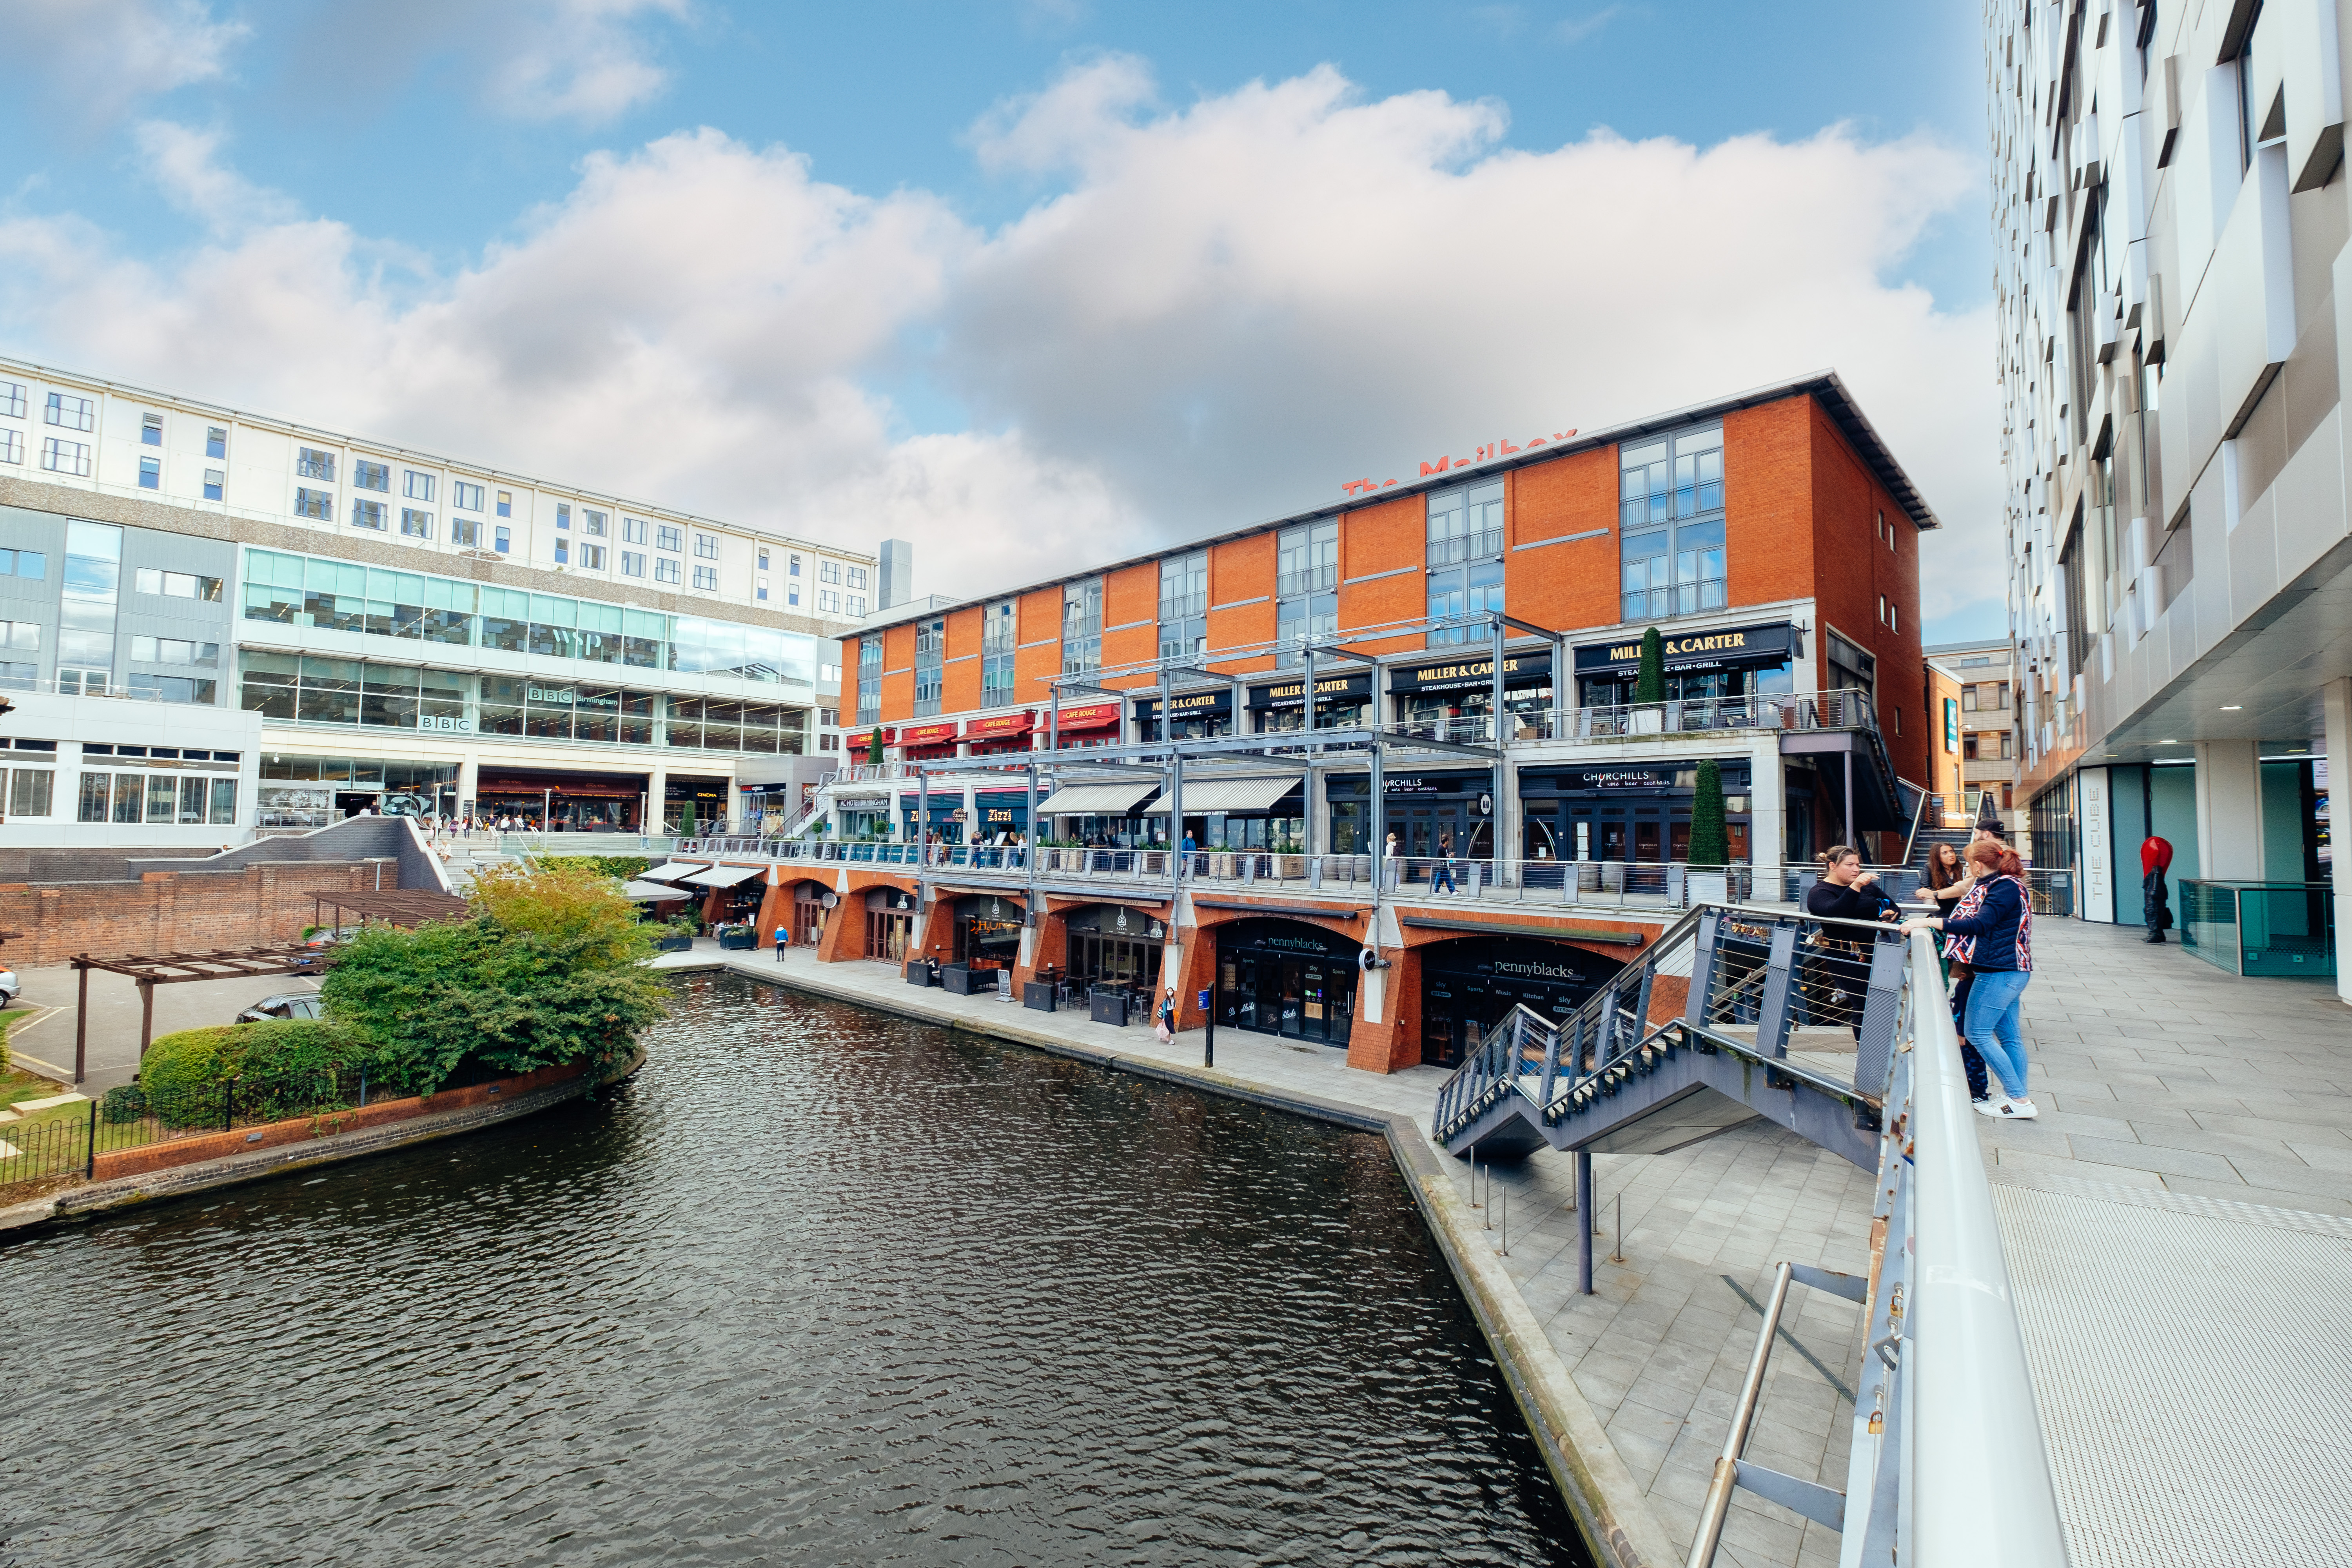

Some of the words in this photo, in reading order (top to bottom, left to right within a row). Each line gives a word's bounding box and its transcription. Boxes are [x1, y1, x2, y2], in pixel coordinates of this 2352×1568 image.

[553, 629, 601, 655] wsp
[1610, 645, 1642, 660] MILL
[1666, 641, 1681, 654] &
[1681, 633, 1745, 652] CARTER
[1417, 667, 1457, 681] MILLER
[1459, 665, 1470, 677] &
[1470, 659, 1518, 675] CARER
[1269, 685, 1301, 698] MILLER
[1314, 680, 1348, 693] CARTER
[1421, 683, 1461, 691] STEAKHOUSE
[532, 691, 570, 701] BBC
[577, 695, 618, 705] Birmingham
[1152, 700, 1177, 711] MIER
[1178, 699, 1185, 708] &
[1185, 695, 1215, 707] CARTER
[1294, 705, 1326, 714] WEME
[423, 718, 469, 730] BBC
[1383, 779, 1421, 792] URCHILLS
[1583, 771, 1649, 787] CHURCHILLS
[910, 811, 930, 822] Zii
[987, 809, 1012, 822] Zizzi
[2089, 788, 2101, 847] CUBE
[2092, 856, 2103, 900] THE
[1268, 937, 1322, 949] pennyblacks
[1495, 962, 1573, 977] pennyblacks
[1559, 996, 1571, 1004] sky
